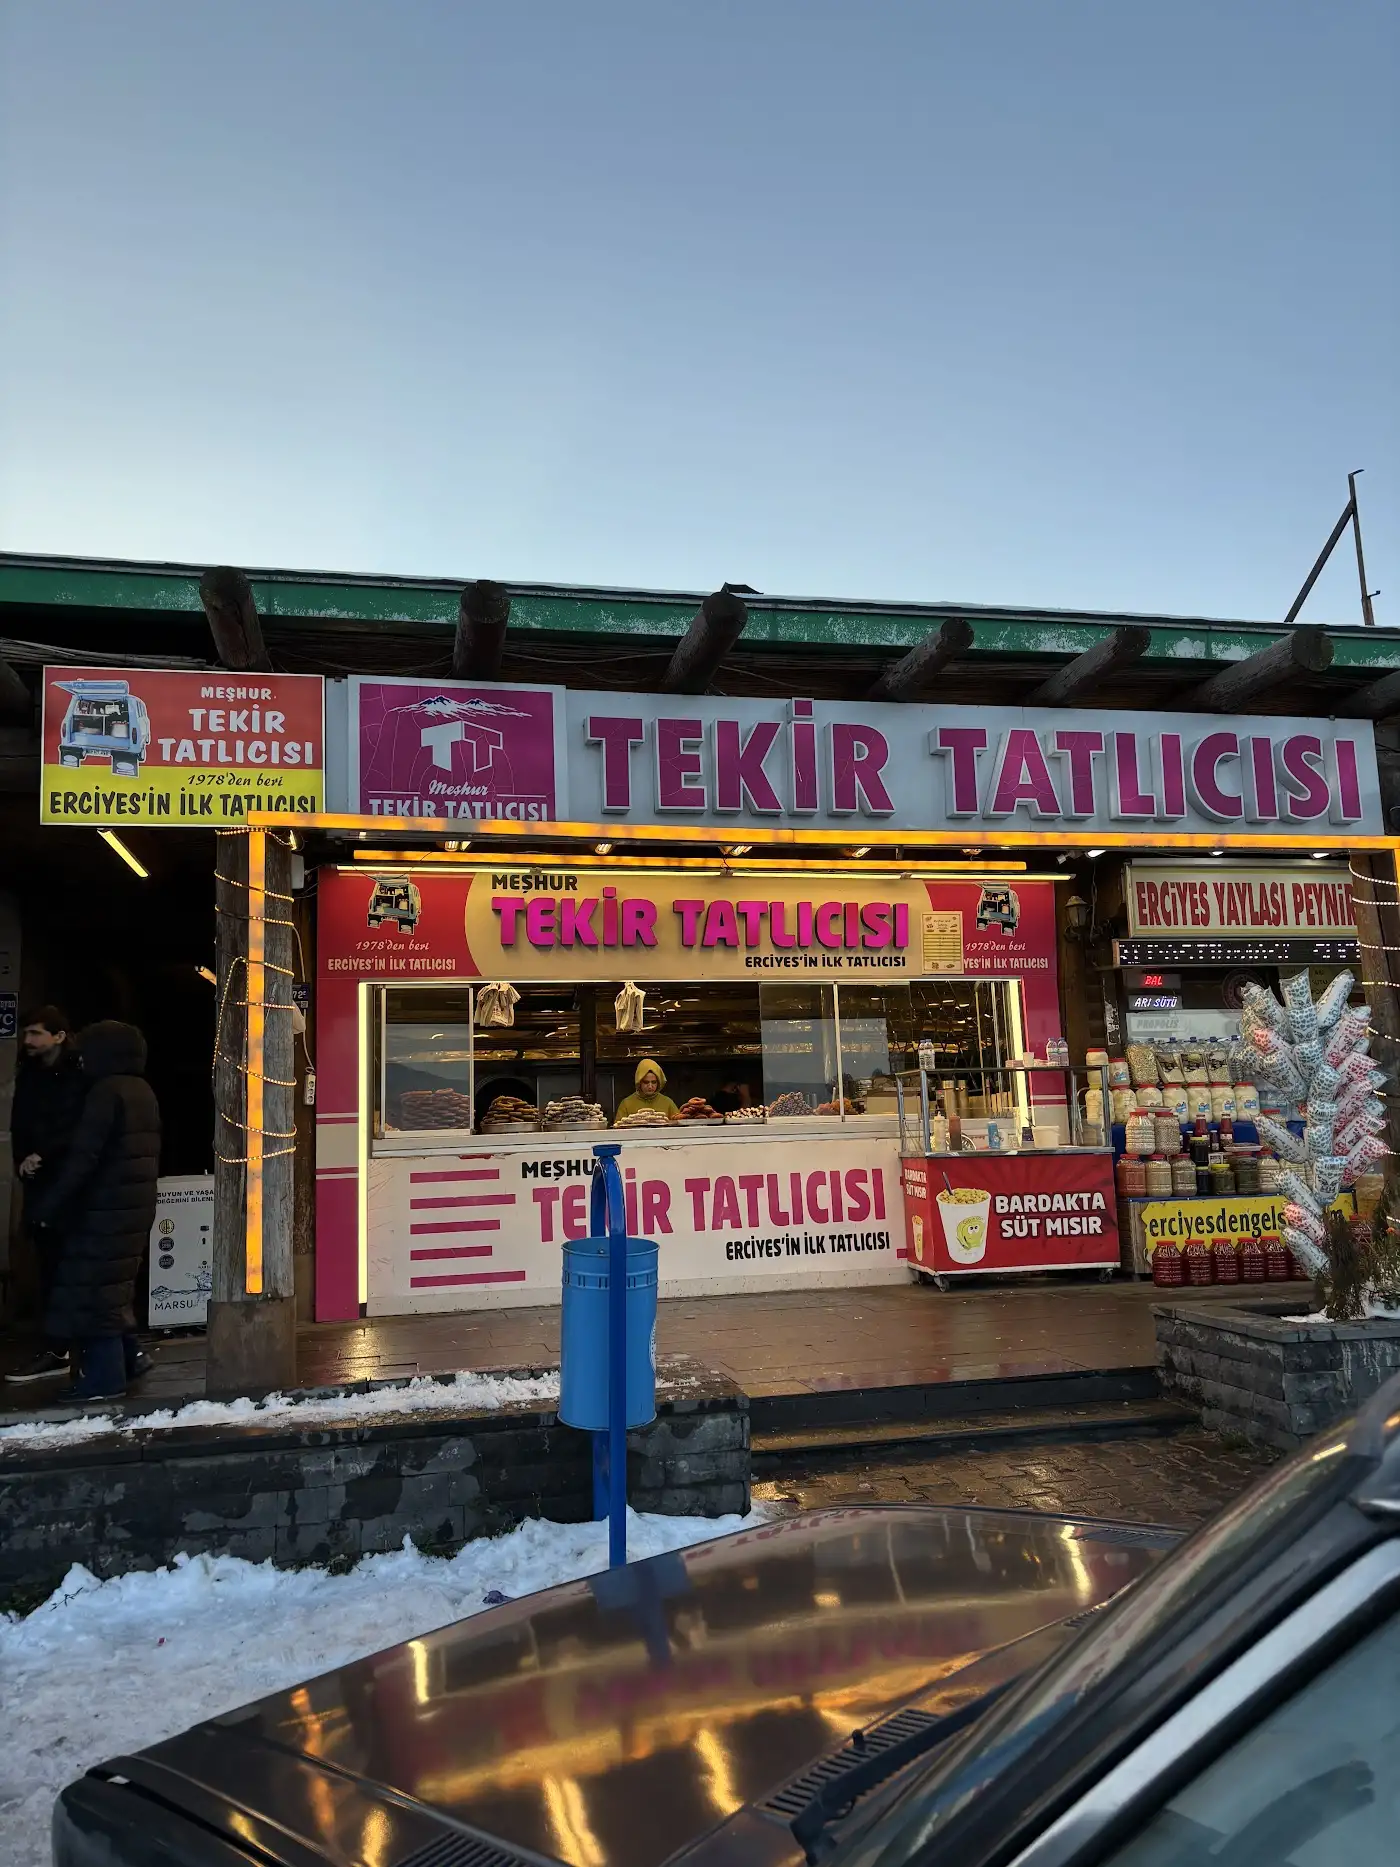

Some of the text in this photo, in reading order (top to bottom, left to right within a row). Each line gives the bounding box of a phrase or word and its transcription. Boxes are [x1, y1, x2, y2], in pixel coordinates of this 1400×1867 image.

[200, 686, 272, 703] MEŞHUR
[188, 703, 286, 734] TEKİR
[157, 738, 313, 765] TATLICISI
[583, 697, 1363, 824] TEKİR TATLICISI
[187, 771, 283, 787] 1978'den beri
[50, 786, 316, 817] ERCİYES'İN İLK TATLICISI
[369, 796, 547, 821] TEKİR TATLICISI
[491, 874, 578, 894] MEŞHUR
[1136, 881, 1211, 926] ERCİYES
[1212, 881, 1289, 926] YAYLASI
[491, 886, 658, 947] TEKİR
[672, 899, 909, 948] TATLICISI
[327, 955, 456, 971] ERCİYES'İN İLK TATLICISI
[745, 954, 906, 968] ERCİYES'İN İLK TATLICISI
[963, 956, 1049, 968] YES'İN İLK TATLICISI
[1144, 975, 1163, 986] BAL
[1134, 995, 1178, 1008] ARI SÜTÜ
[521, 1158, 597, 1181] MEŞHU
[532, 1167, 887, 1243] TEİR TATLICISI
[995, 1192, 1106, 1214] BARDAKTA
[1001, 1216, 1041, 1238] SÜT
[1045, 1216, 1103, 1236] MISIR
[1149, 1206, 1288, 1239] erciyesdengels
[725, 1231, 890, 1261] ERCİYES'İN İLK TATLICISI
[154, 1299, 194, 1311] MARSU
